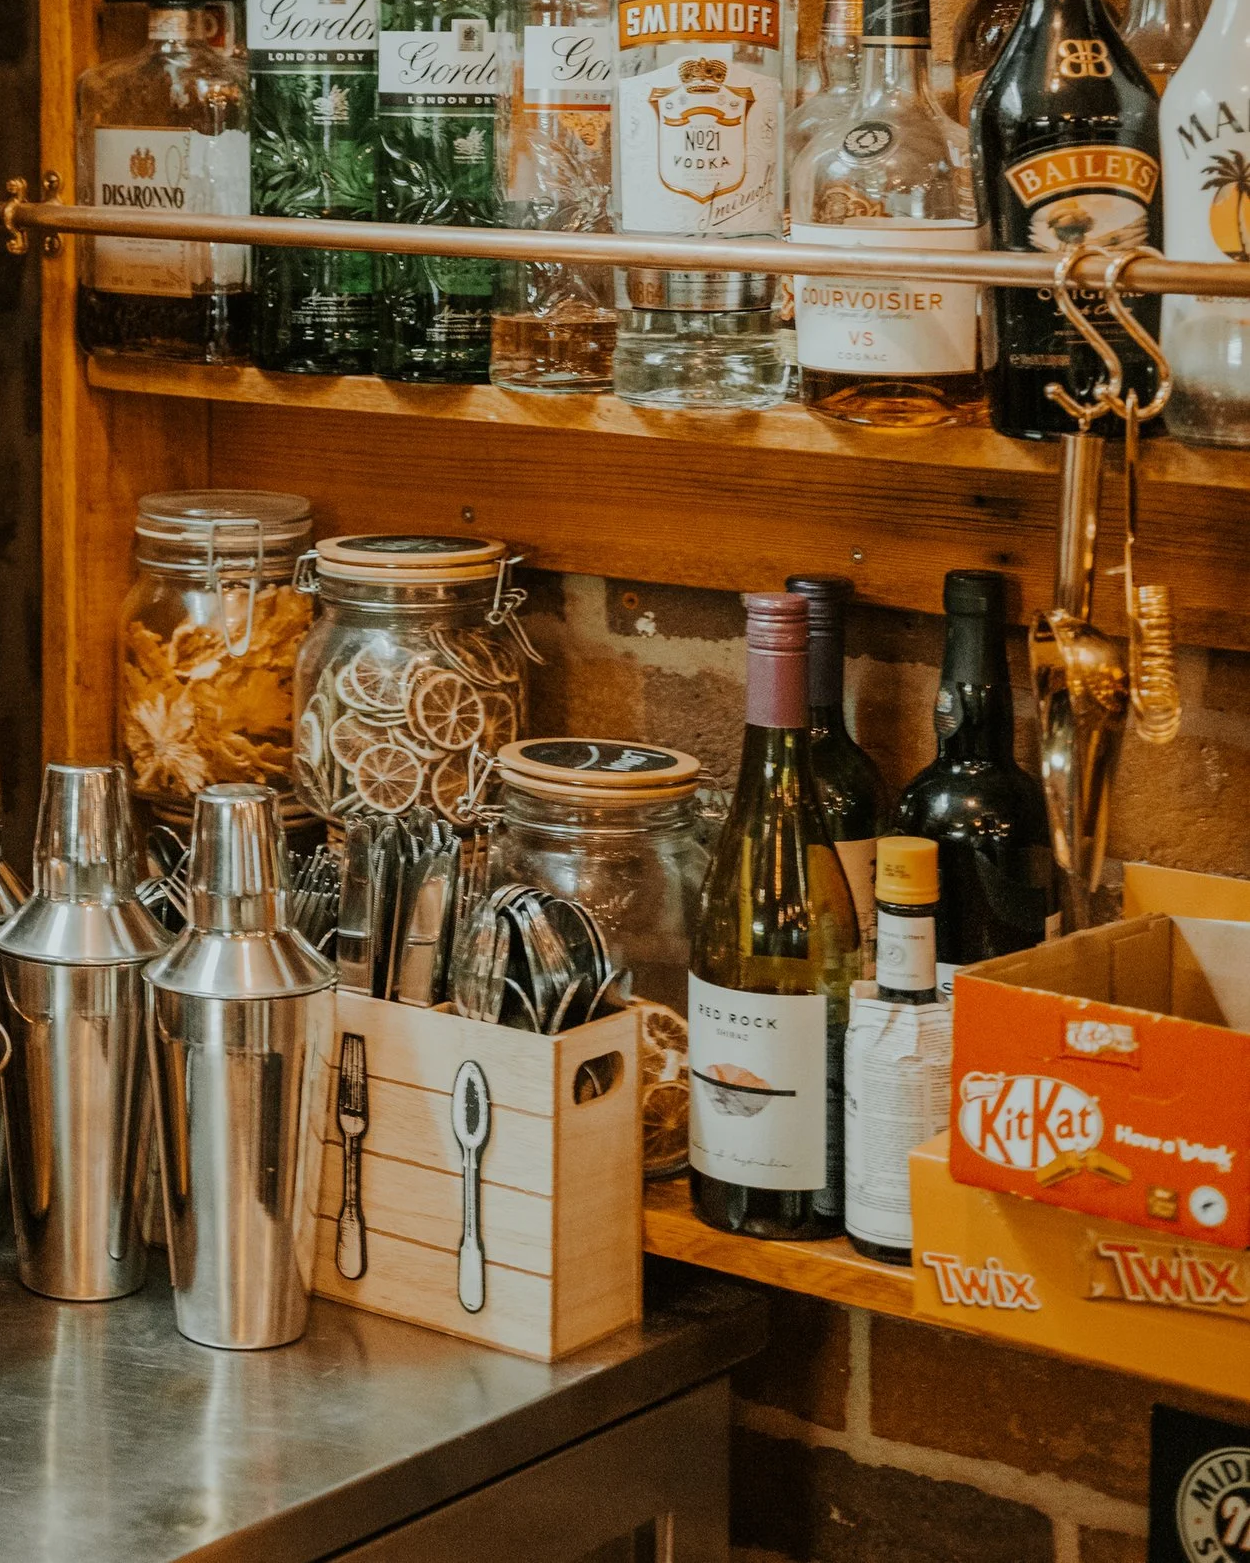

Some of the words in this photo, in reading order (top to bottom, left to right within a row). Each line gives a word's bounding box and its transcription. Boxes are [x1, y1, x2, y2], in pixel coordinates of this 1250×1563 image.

[625, 1, 773, 38] SMIRNOFF
[268, 52, 328, 62] LONDON
[336, 52, 365, 62] DRY
[407, 95, 468, 105] LONDON
[575, 93, 608, 101] PREM
[674, 156, 731, 169] VODKA
[1018, 154, 1152, 194] BAILEYS
[102, 183, 185, 209] DISARONNO
[802, 287, 943, 311] COURVOISIER
[848, 331, 875, 347] VS
[837, 351, 888, 363] COGNAC
[698, 1003, 722, 1020] RED
[728, 1012, 779, 1030] ROCK
[923, 1251, 1042, 1311] Twix
[1097, 1240, 1250, 1304] Twix
